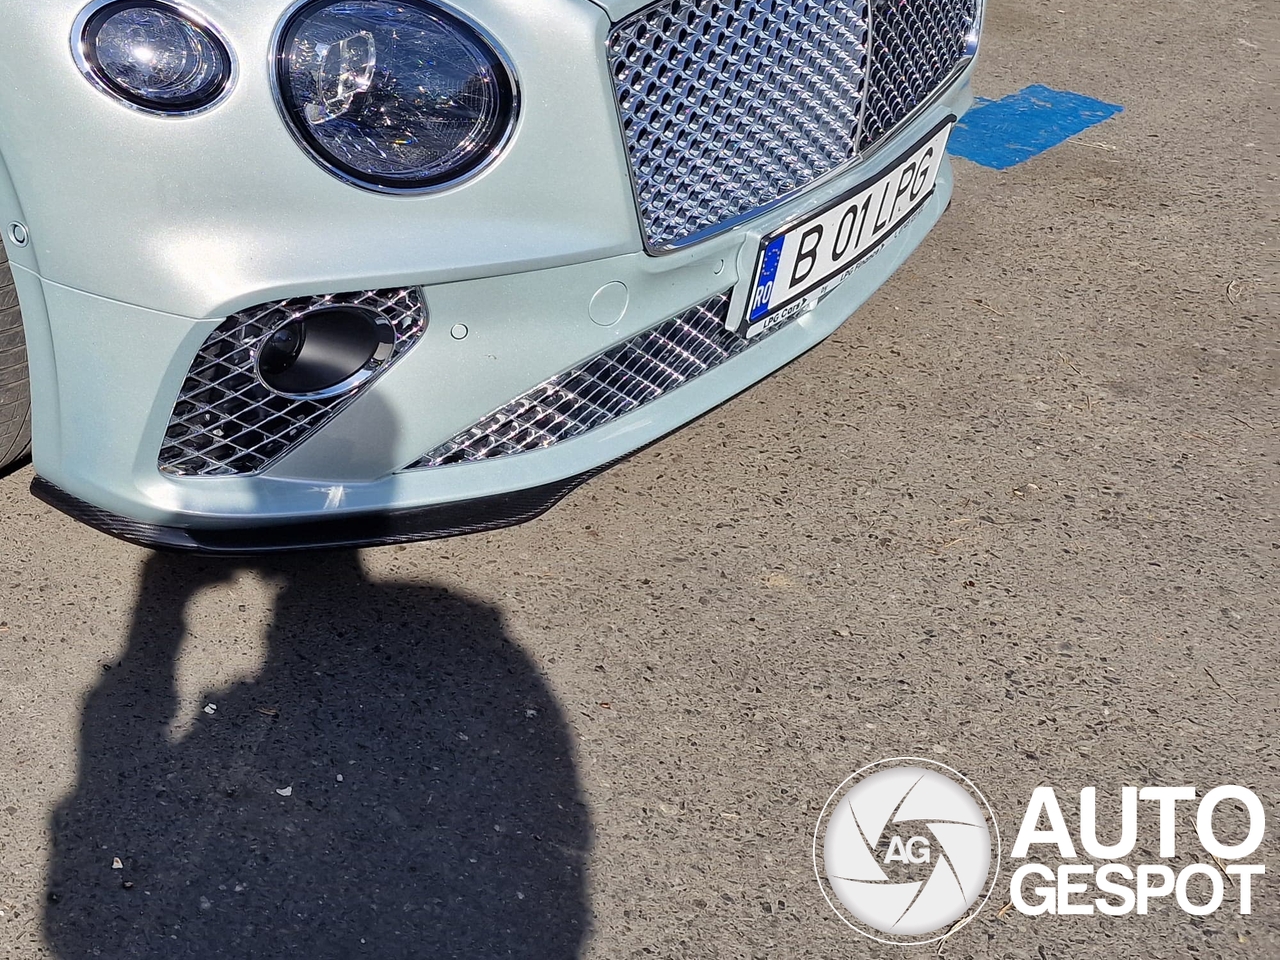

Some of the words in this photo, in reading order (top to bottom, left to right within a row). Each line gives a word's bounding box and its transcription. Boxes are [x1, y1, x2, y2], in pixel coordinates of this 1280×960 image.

[788, 223, 824, 290] B
[831, 193, 872, 262] 01
[872, 146, 934, 237] LPG
[753, 280, 773, 311] RO
[763, 313, 780, 329] LPG
